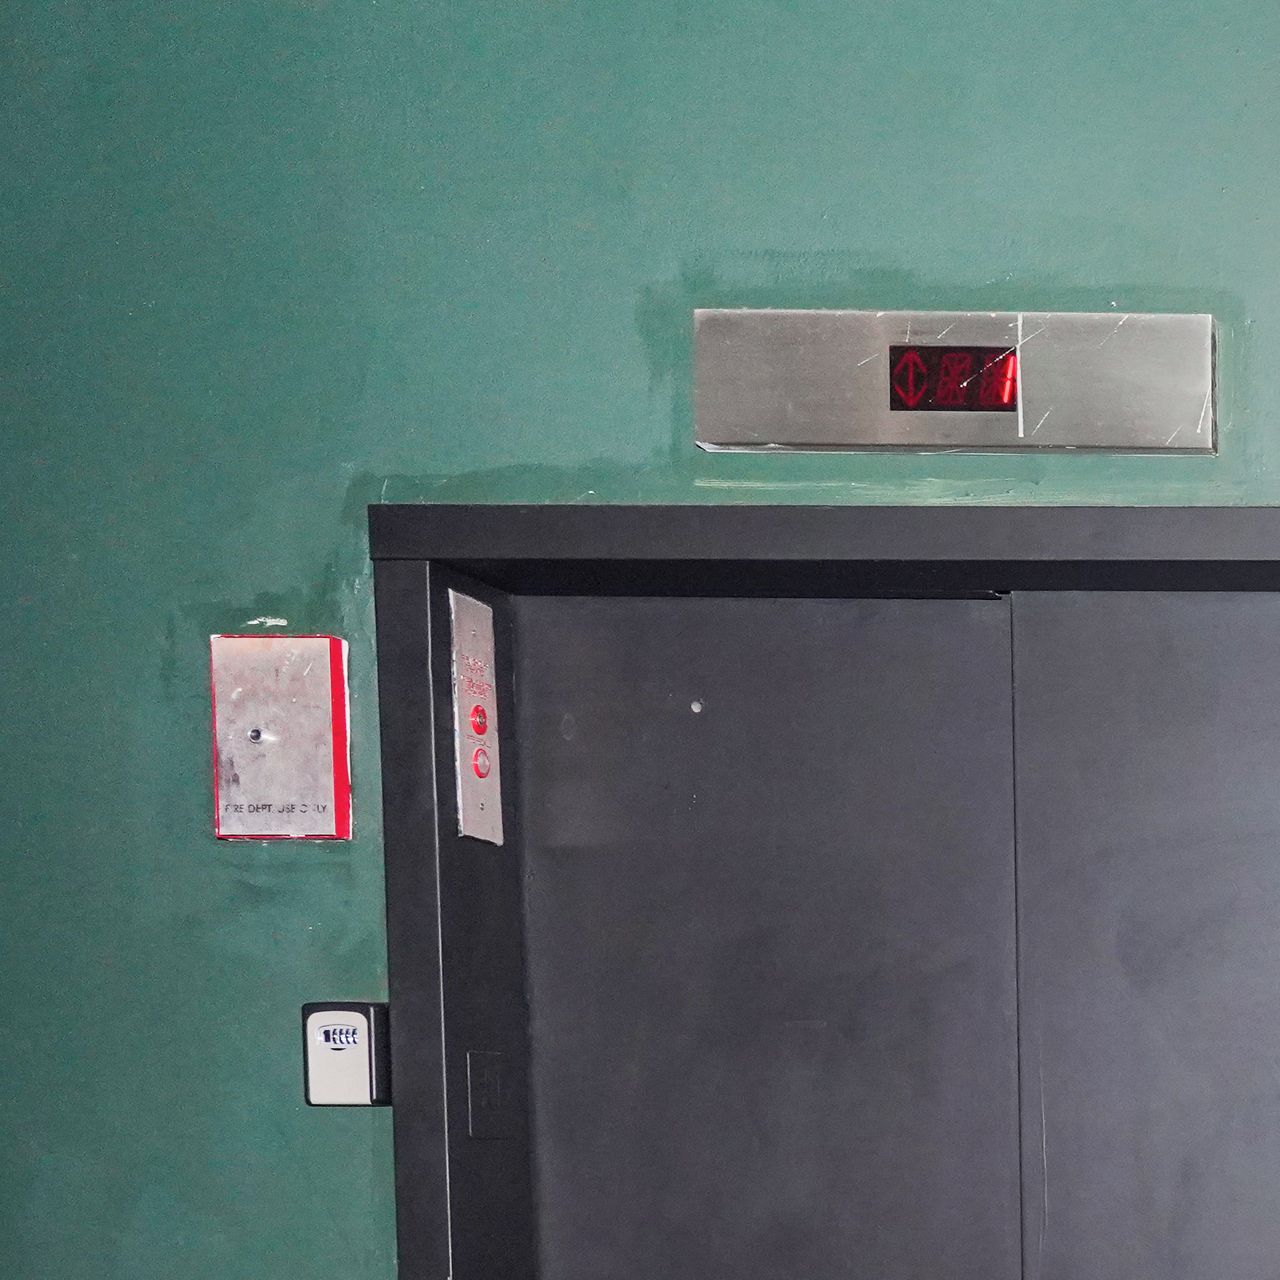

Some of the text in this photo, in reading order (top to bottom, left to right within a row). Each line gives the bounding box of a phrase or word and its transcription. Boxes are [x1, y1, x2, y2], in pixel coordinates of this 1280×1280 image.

[1002, 355, 1015, 404] 1
[224, 803, 244, 814] FRE
[299, 803, 328, 814] OLY
